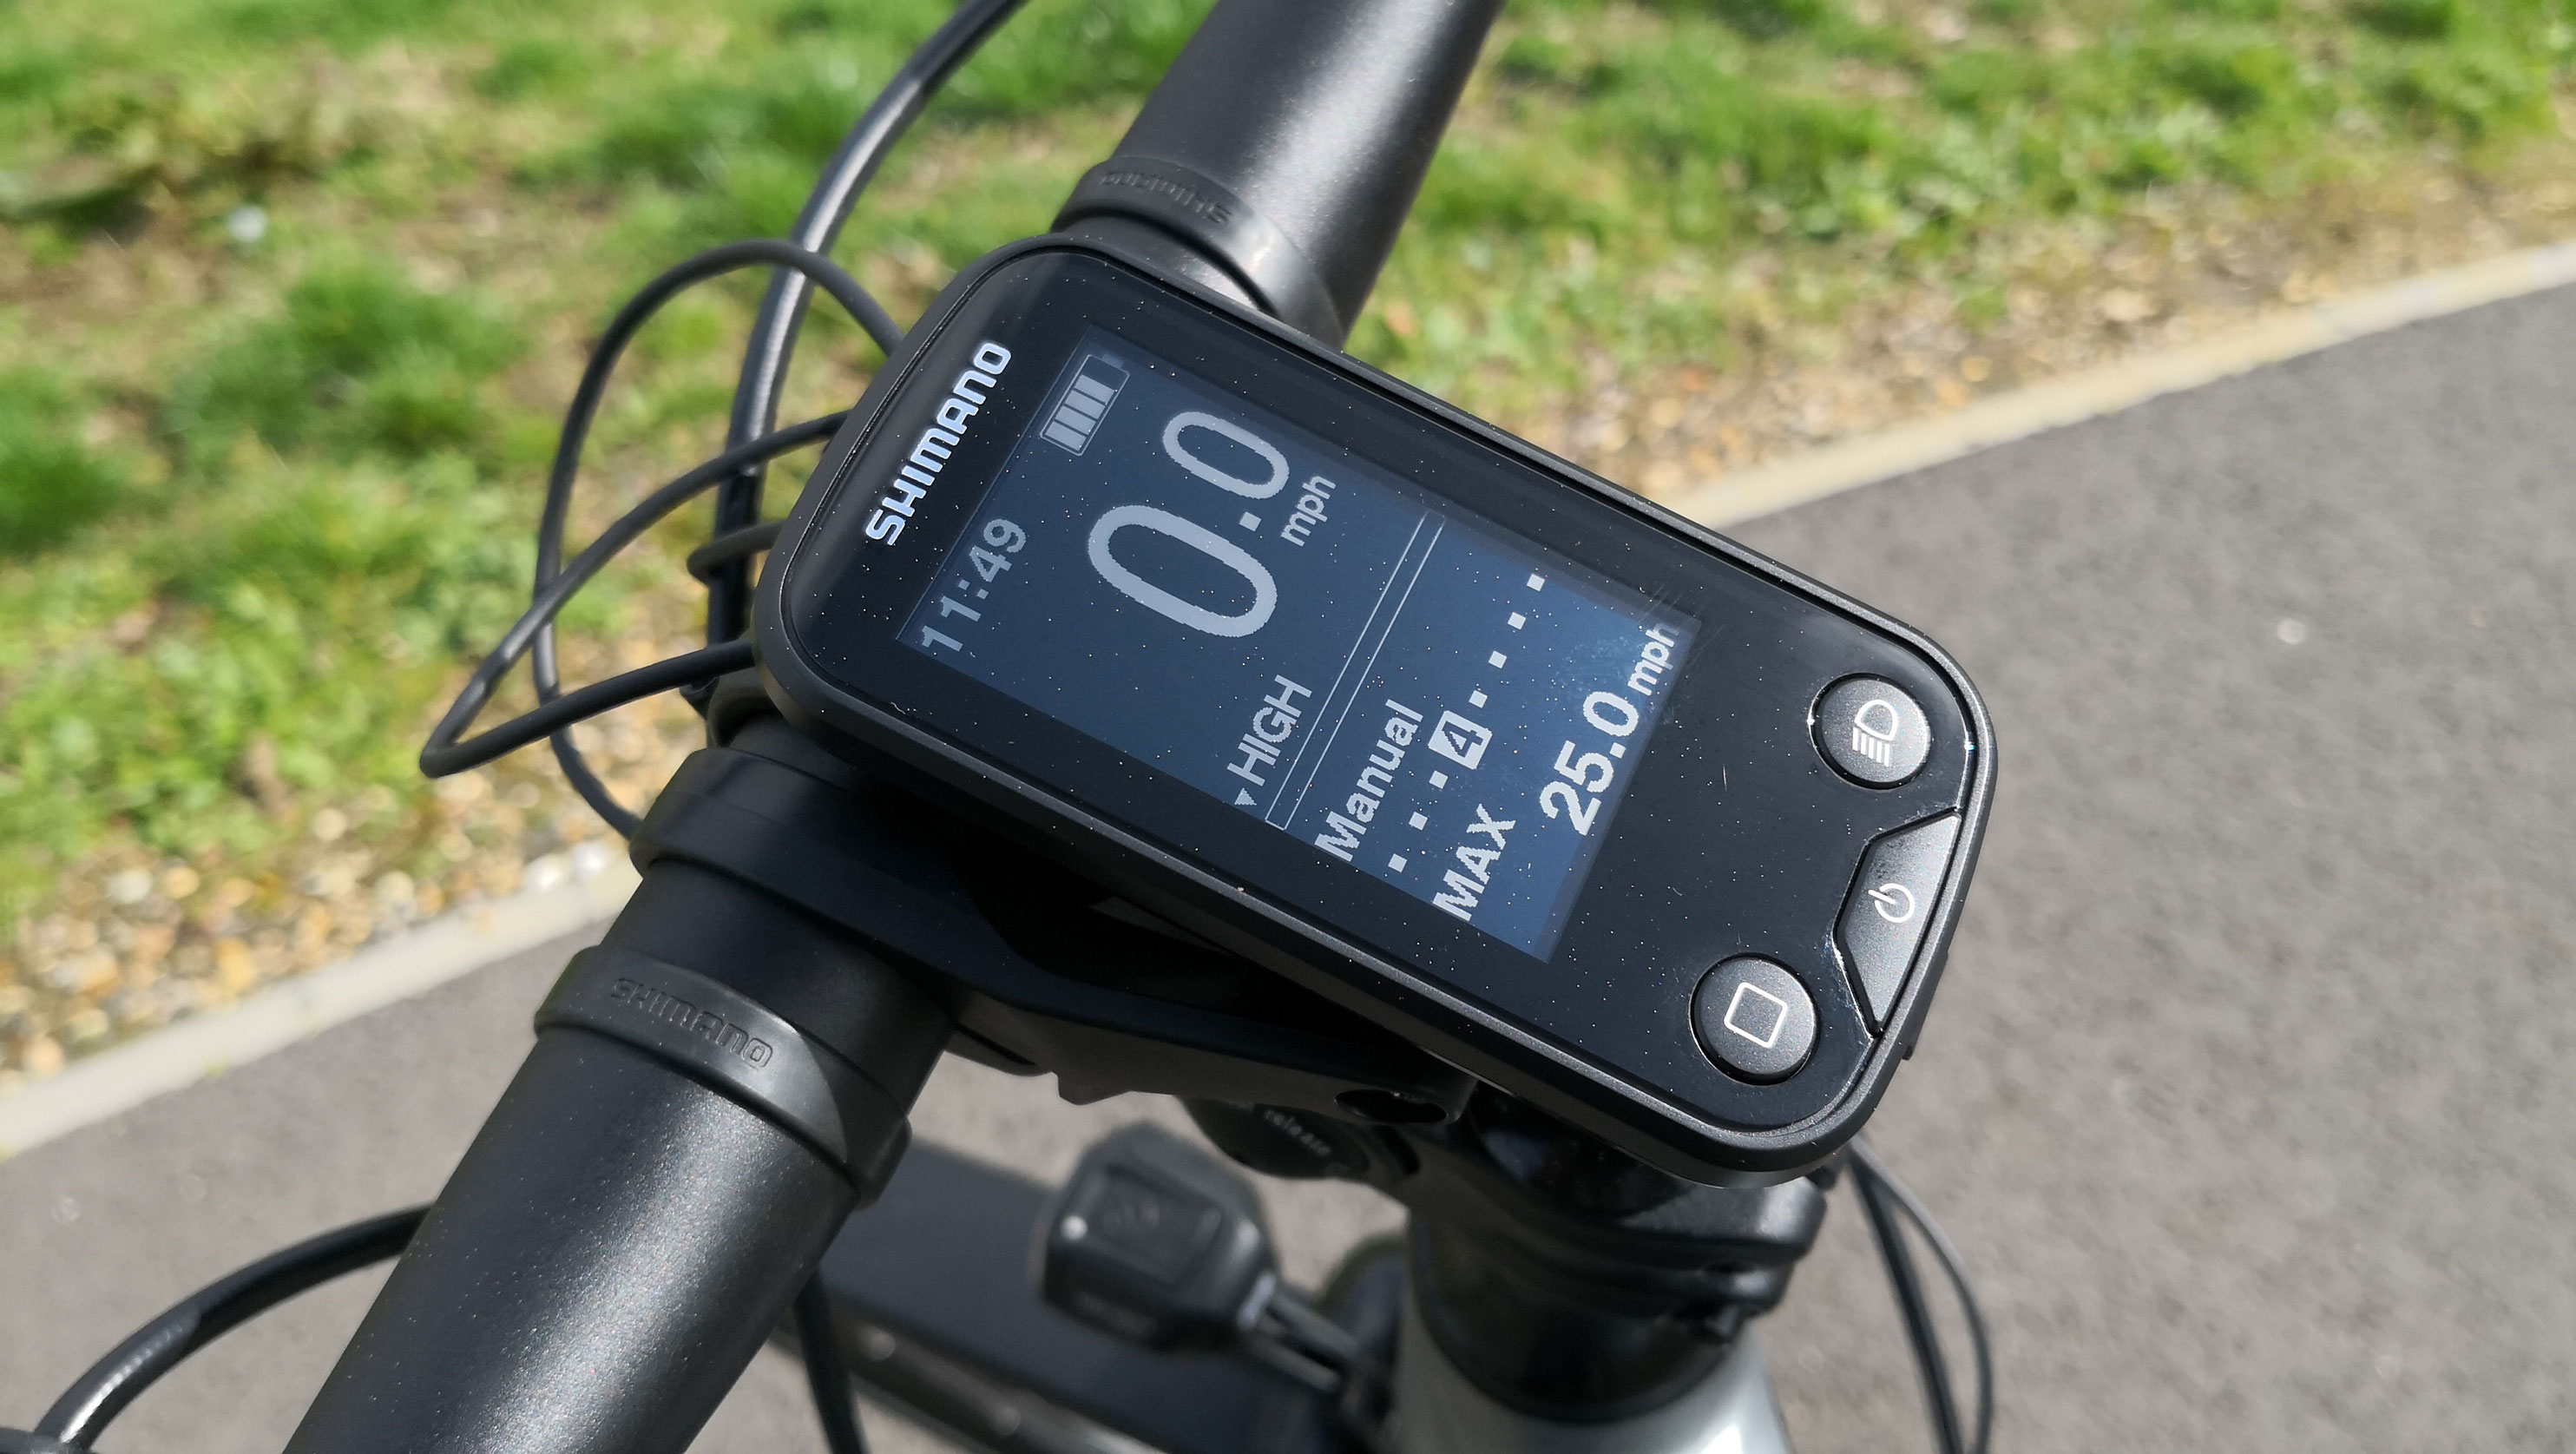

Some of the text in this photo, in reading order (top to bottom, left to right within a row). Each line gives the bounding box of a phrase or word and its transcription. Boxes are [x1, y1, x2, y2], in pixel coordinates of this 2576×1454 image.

[865, 342, 1012, 546] SHIMANO
[920, 518, 1027, 652] 11:49
[1088, 411, 1337, 638] 0.0 mph
[1226, 674, 1311, 786] HIGH
[1314, 699, 1423, 862] Manual
[1432, 621, 1680, 922] MAX 25.0 mph
[1442, 720, 1483, 758] 4
[611, 977, 773, 1070] SHIMANO
